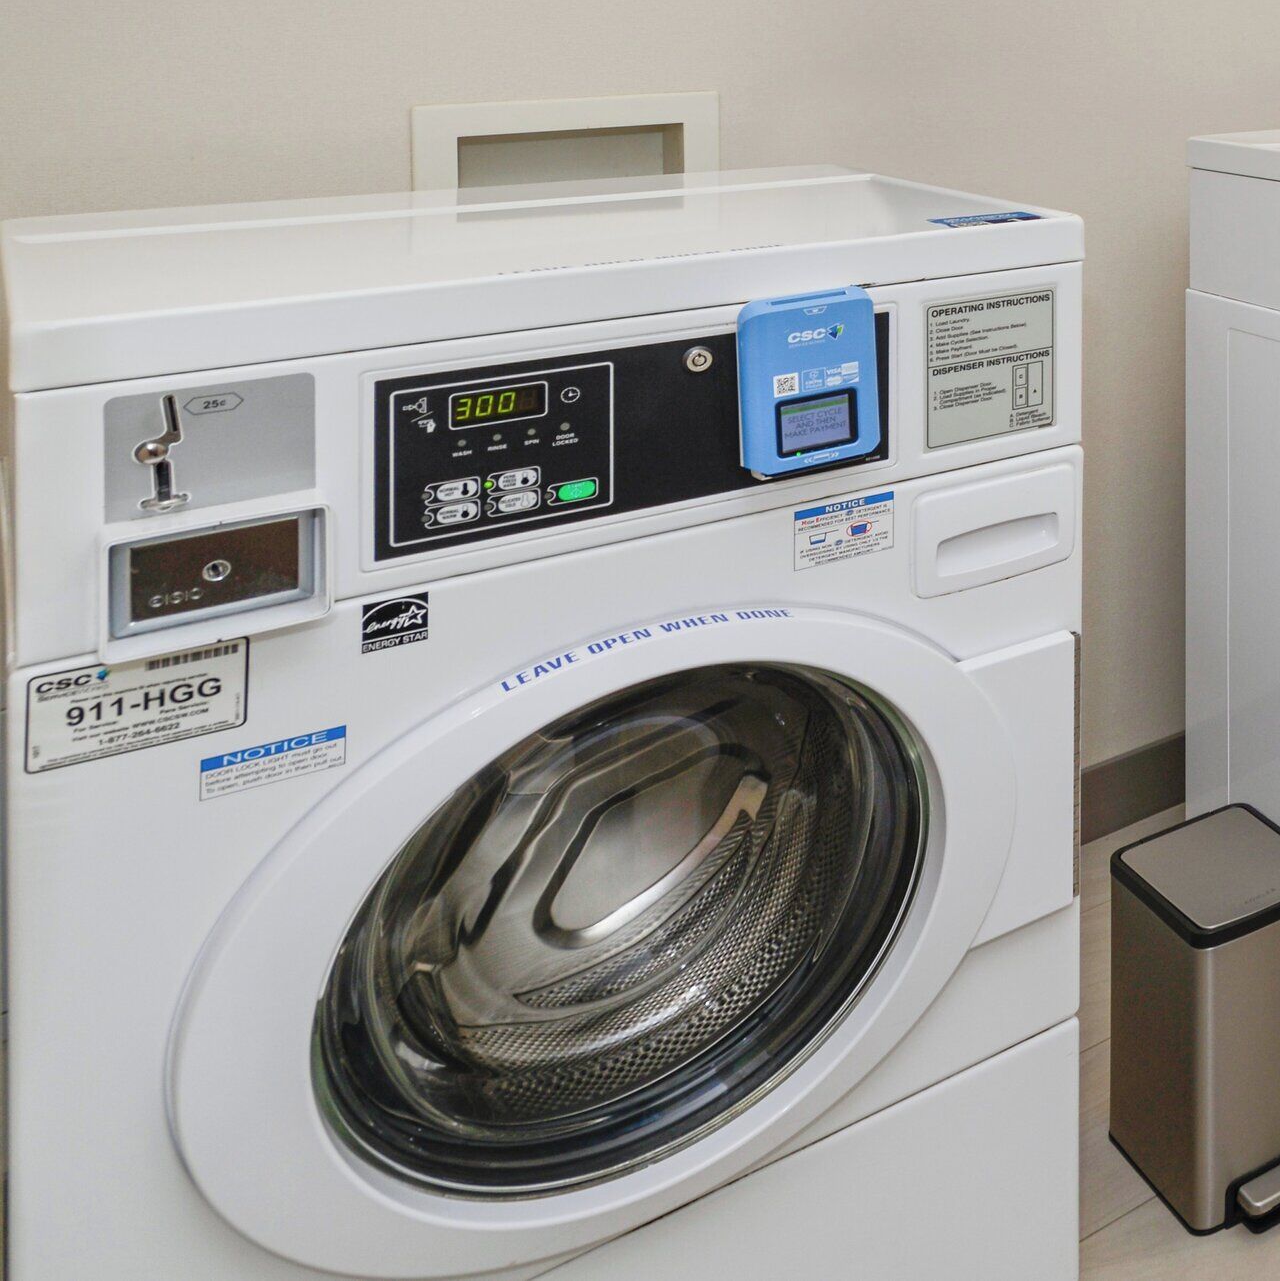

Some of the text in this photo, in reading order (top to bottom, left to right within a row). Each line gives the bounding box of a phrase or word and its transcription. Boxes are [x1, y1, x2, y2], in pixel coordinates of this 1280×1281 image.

[931, 294, 1050, 318] OPERATING INSTRUCTIONS
[788, 328, 826, 343] CSC
[932, 350, 1050, 377] DISPENSER INSTRUCTIONS
[456, 391, 516, 421] 300
[787, 406, 841, 424] SELECT CYCLE
[784, 420, 846, 439] MAKE PAYMENT
[796, 416, 836, 429] AND THEN
[523, 438, 540, 446] SPIN
[552, 438, 579, 447] LOCKED
[555, 432, 576, 440] DOOR
[451, 450, 473, 458] WASH
[486, 443, 508, 452] RINSE
[825, 499, 866, 513] NOTICE
[362, 631, 428, 653] ENERGY STAR
[500, 609, 795, 693] LEAVE OPEN WHEN DONE
[36, 674, 93, 694] CSC
[66, 677, 222, 727] 911-HGG
[223, 731, 327, 765] NOTICE
[205, 768, 233, 780] DOOR
[235, 762, 261, 773] LOCK
[262, 753, 290, 766] LIGHT
[291, 749, 311, 758] must
[325, 742, 337, 750] out
[205, 777, 232, 787] before
[234, 765, 277, 780] attempting
[288, 758, 308, 767] open
[242, 775, 264, 786] push
[265, 771, 284, 779] door
[294, 763, 312, 771] then
[313, 759, 328, 768] pull
